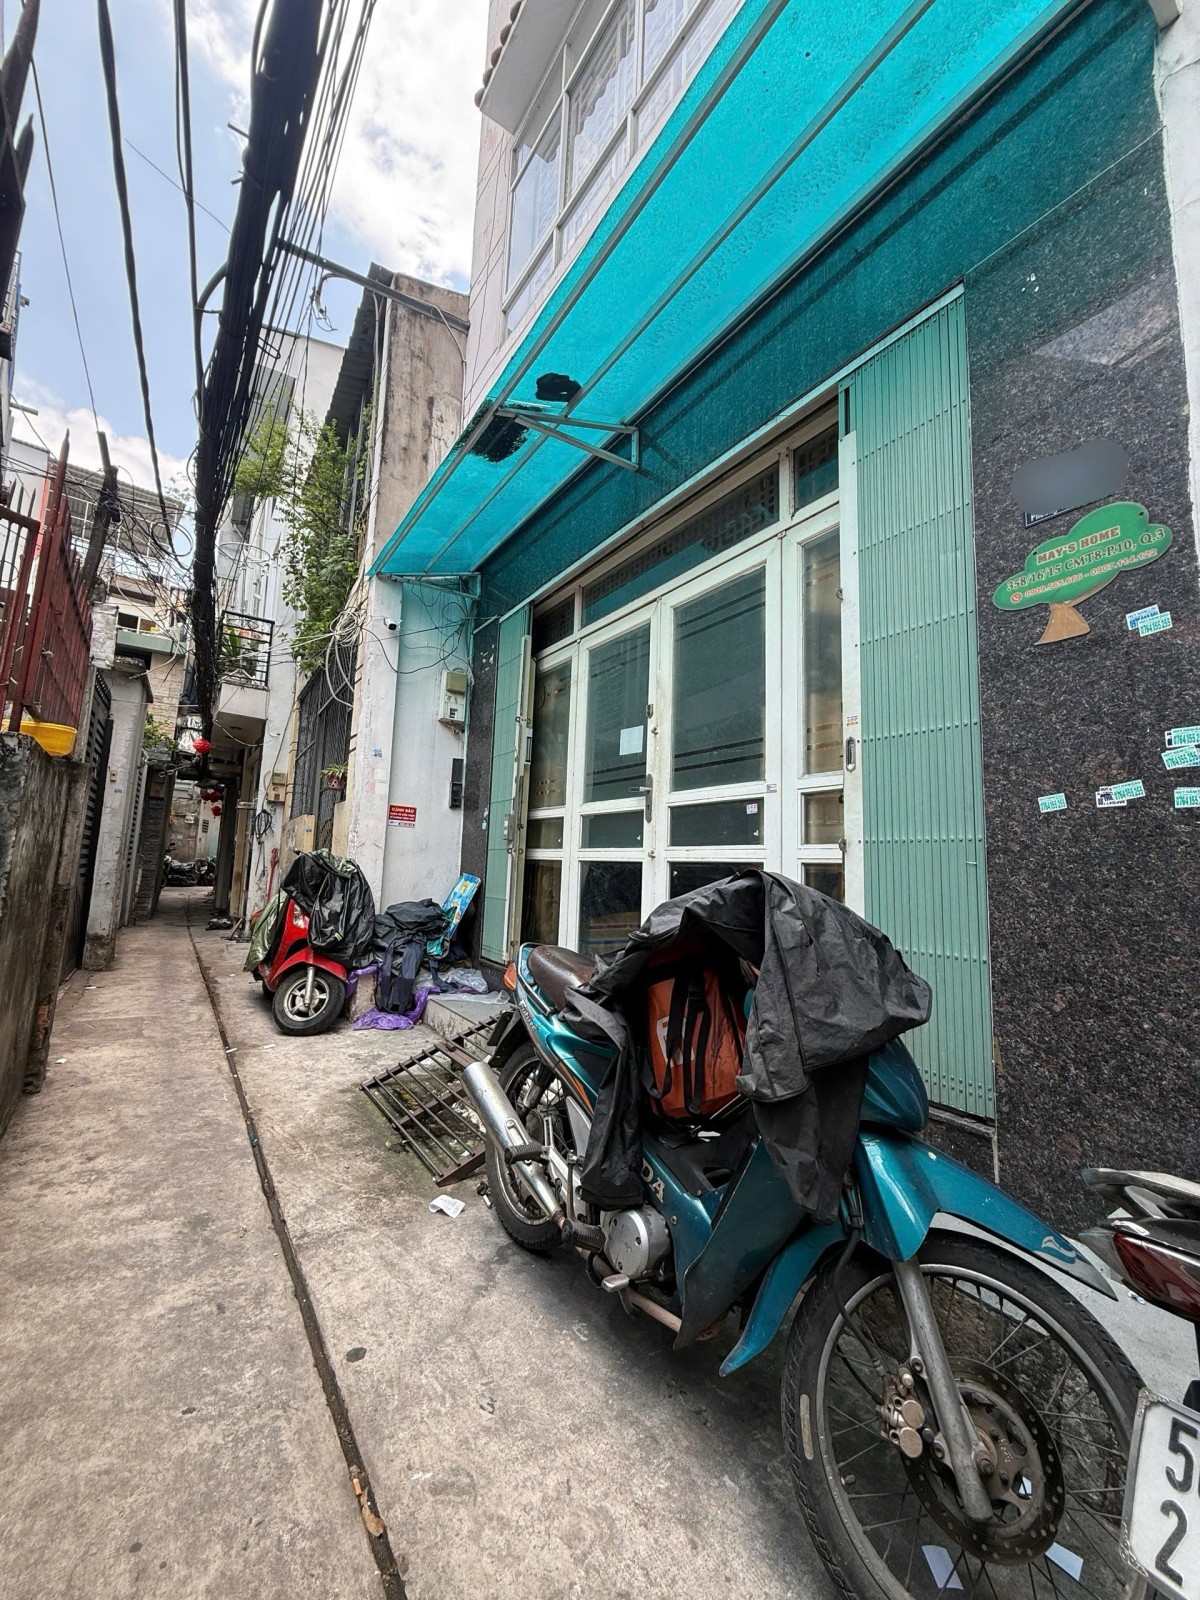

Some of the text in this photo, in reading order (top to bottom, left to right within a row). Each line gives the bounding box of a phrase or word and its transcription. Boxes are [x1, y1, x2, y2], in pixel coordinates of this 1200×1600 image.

[1007, 564, 1062, 591] 358/16/15
[1139, 528, 1165, 545] Q.3
[1037, 526, 1121, 565] MAY'S HOME
[1165, 1416, 1200, 1498] 5
